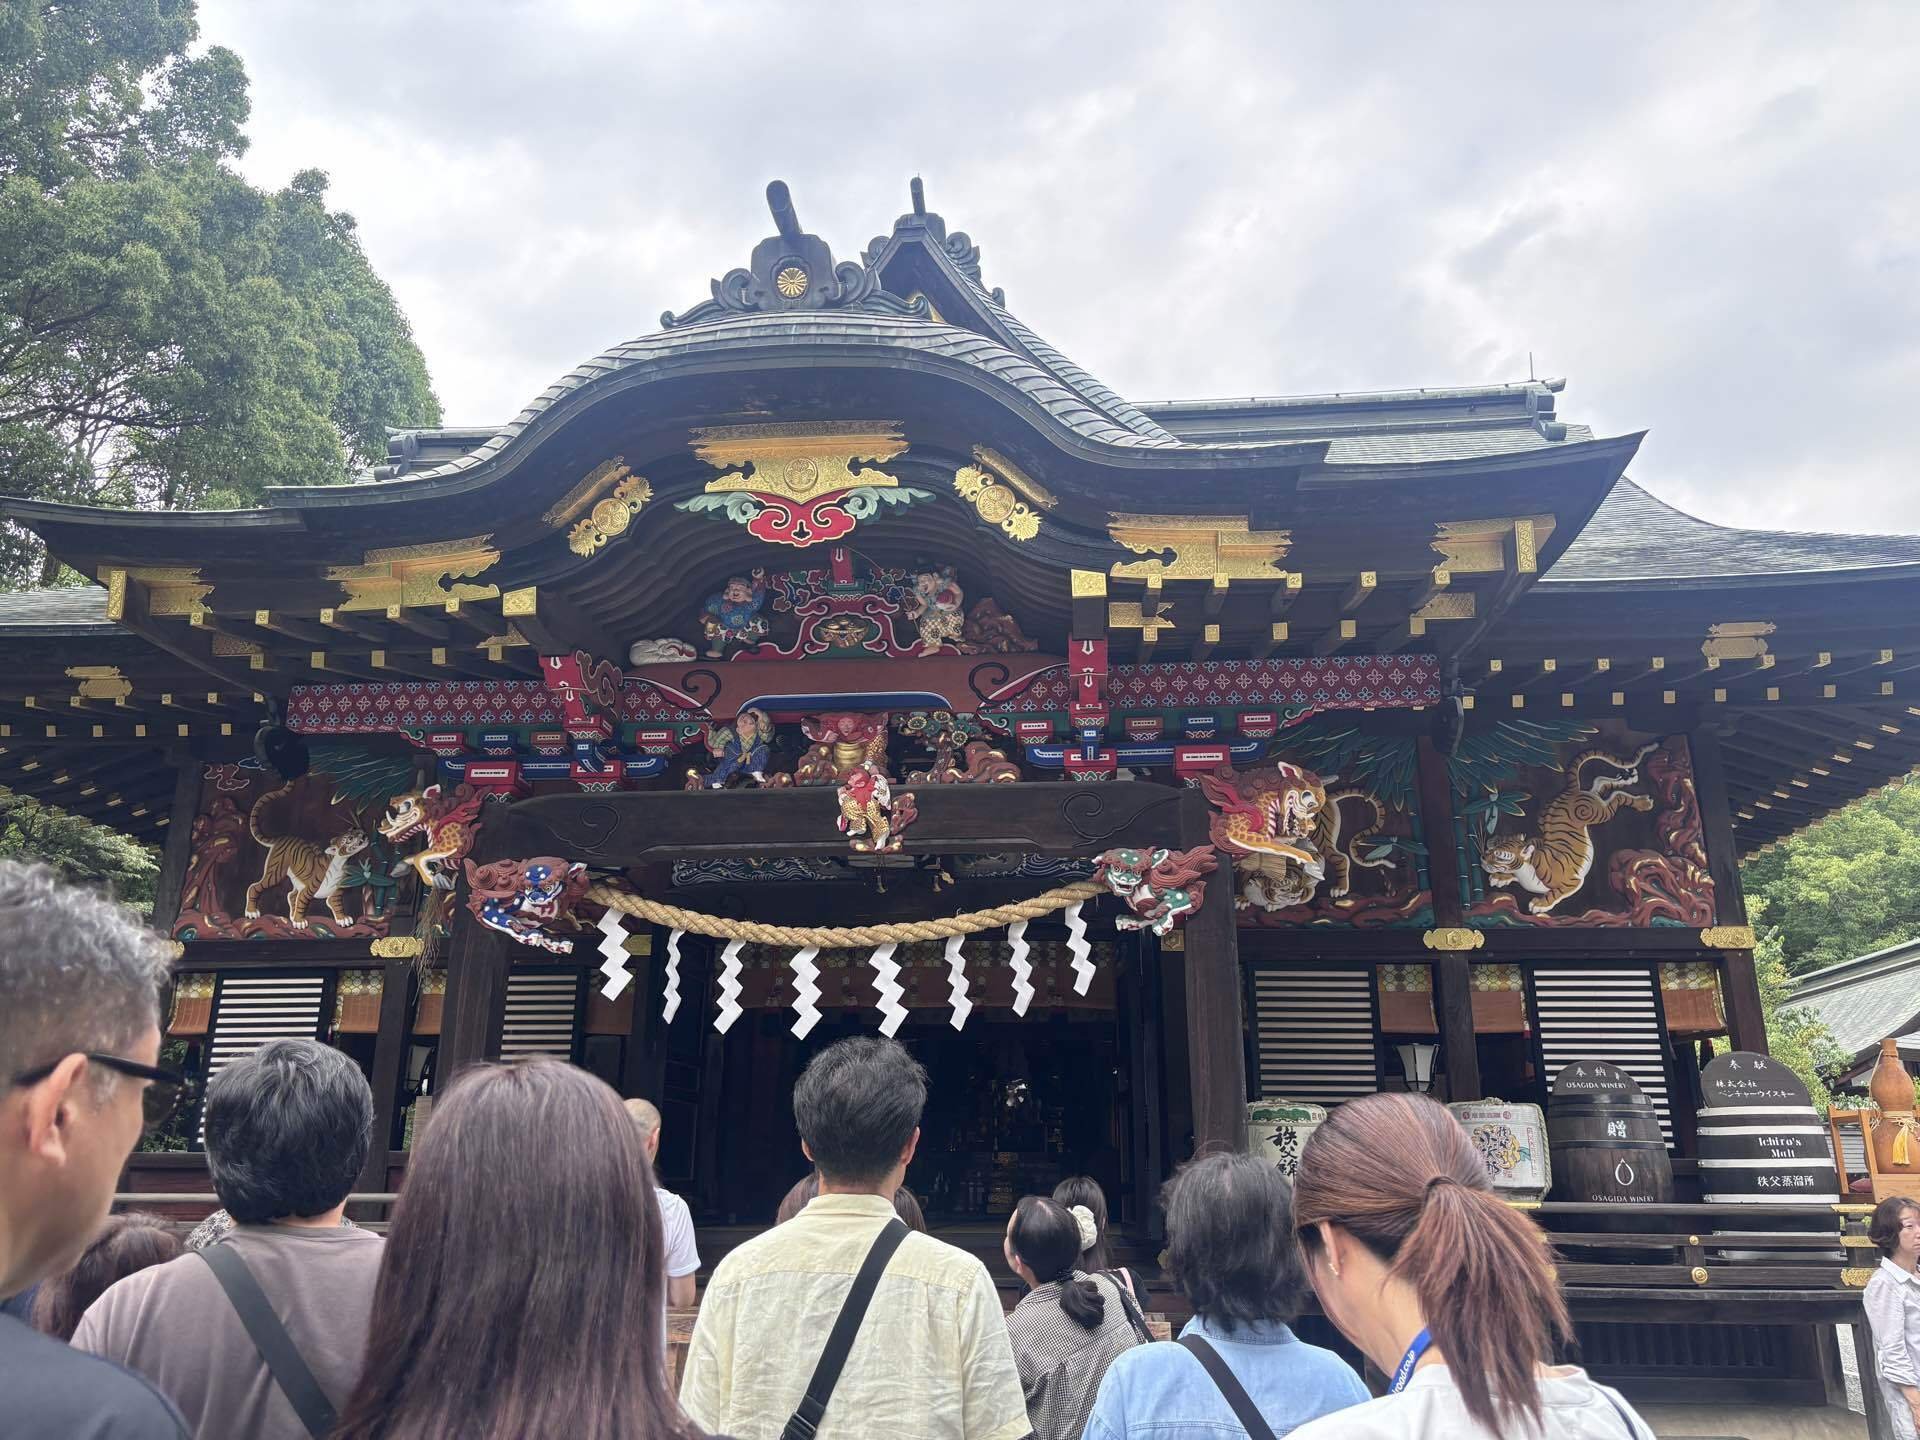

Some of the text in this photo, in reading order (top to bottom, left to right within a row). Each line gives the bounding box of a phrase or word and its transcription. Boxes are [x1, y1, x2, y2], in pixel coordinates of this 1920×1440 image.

[1601, 1082, 1627, 1090] WINERY
[1715, 1079, 1758, 1088] 株式会社
[1607, 1119, 1627, 1139] 贈
[1758, 1136, 1802, 1147] Ichiro's
[1770, 1148, 1796, 1158] Malt
[1757, 1175, 1815, 1188] 秩父蒸溜所
[1629, 1196, 1655, 1204] WINERY
